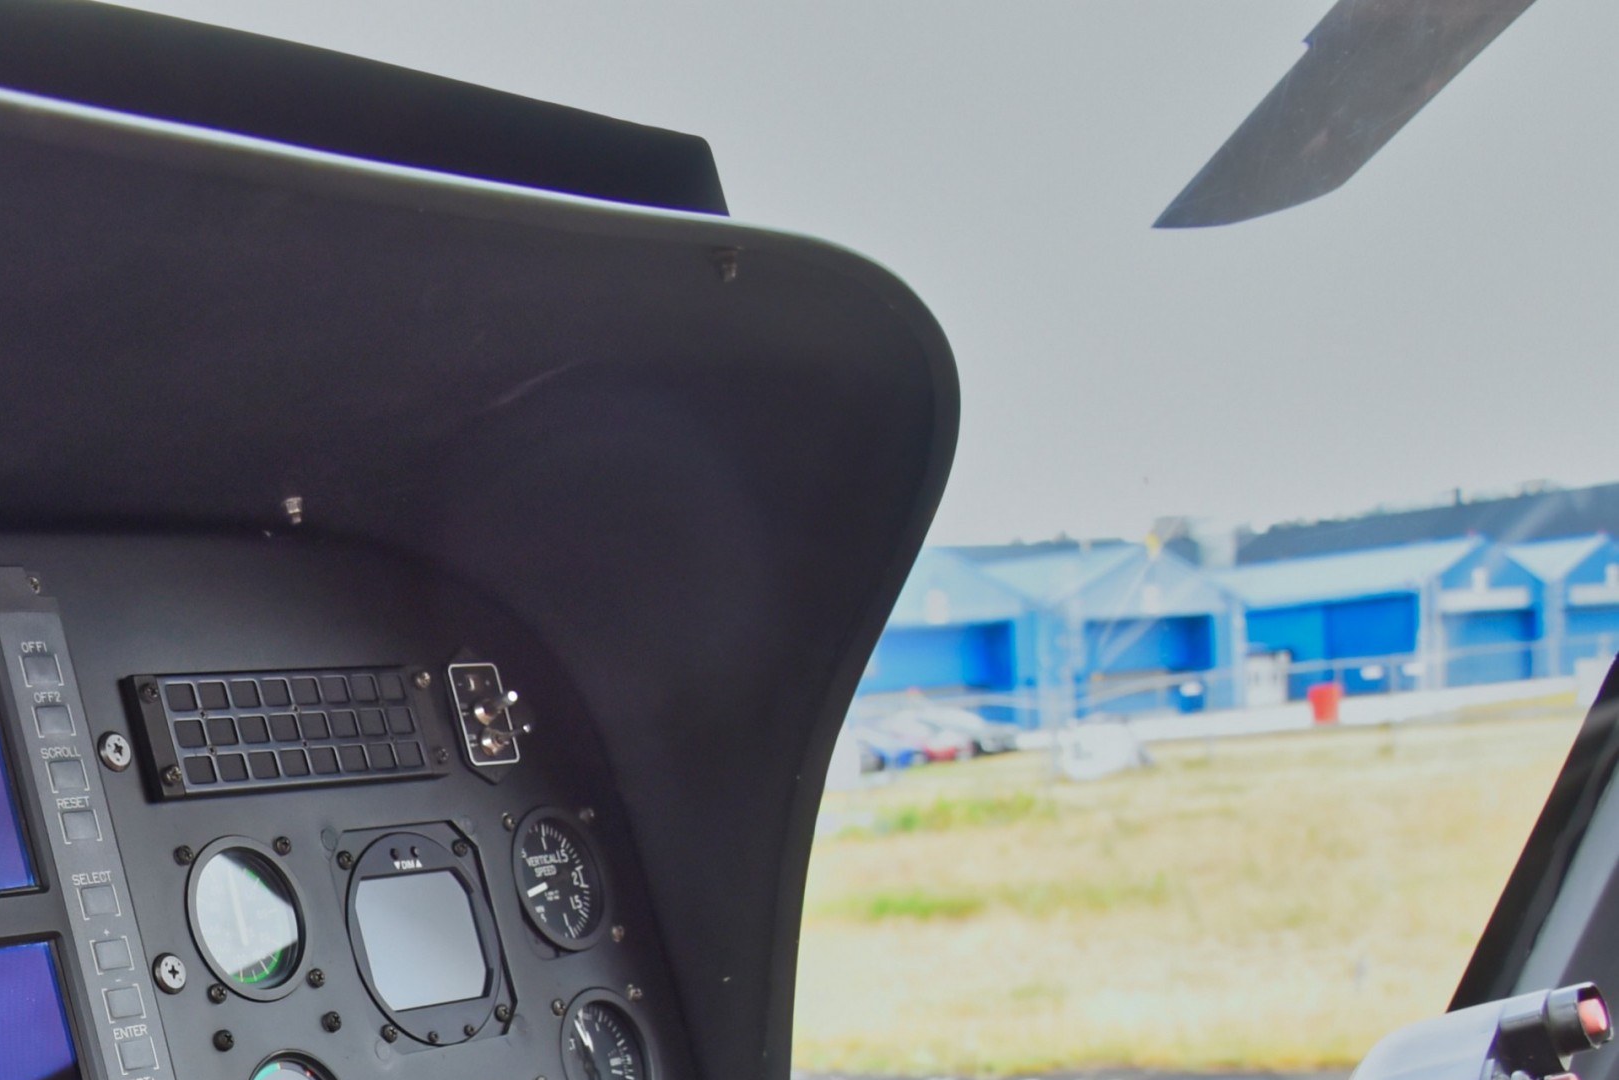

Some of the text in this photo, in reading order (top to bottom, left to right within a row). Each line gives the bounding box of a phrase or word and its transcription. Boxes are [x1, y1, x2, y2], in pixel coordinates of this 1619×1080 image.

[21, 641, 47, 654] OFF1
[34, 692, 61, 703] OFF2
[41, 748, 81, 760] SCROLL
[56, 796, 90, 809] RESET
[526, 854, 557, 867] VERTICAL
[534, 865, 557, 878] SPEED
[72, 871, 112, 886] SELECT
[113, 1024, 148, 1040] ENTER
